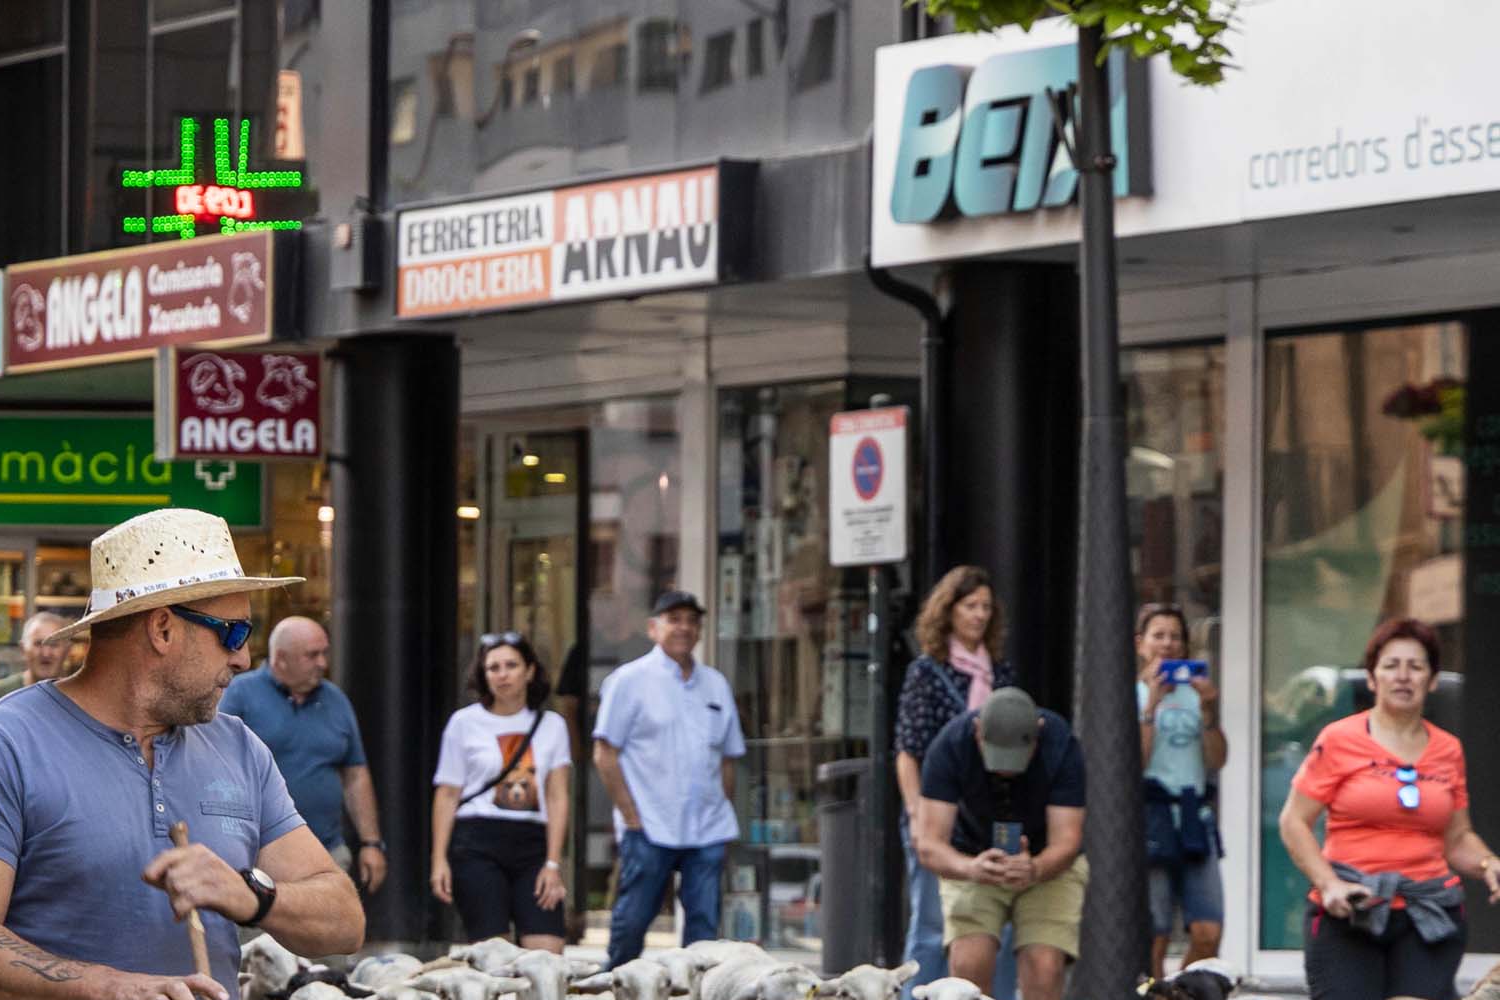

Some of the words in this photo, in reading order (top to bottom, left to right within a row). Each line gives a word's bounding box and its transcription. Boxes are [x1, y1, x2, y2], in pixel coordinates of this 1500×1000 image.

[1249, 127, 1390, 190] corredors
[406, 204, 545, 257] FERRETERIA
[561, 175, 717, 286] ARNAU
[46, 265, 143, 350] ANGELA
[403, 252, 546, 309] DROGUERIA
[180, 415, 318, 454] ANGELA
